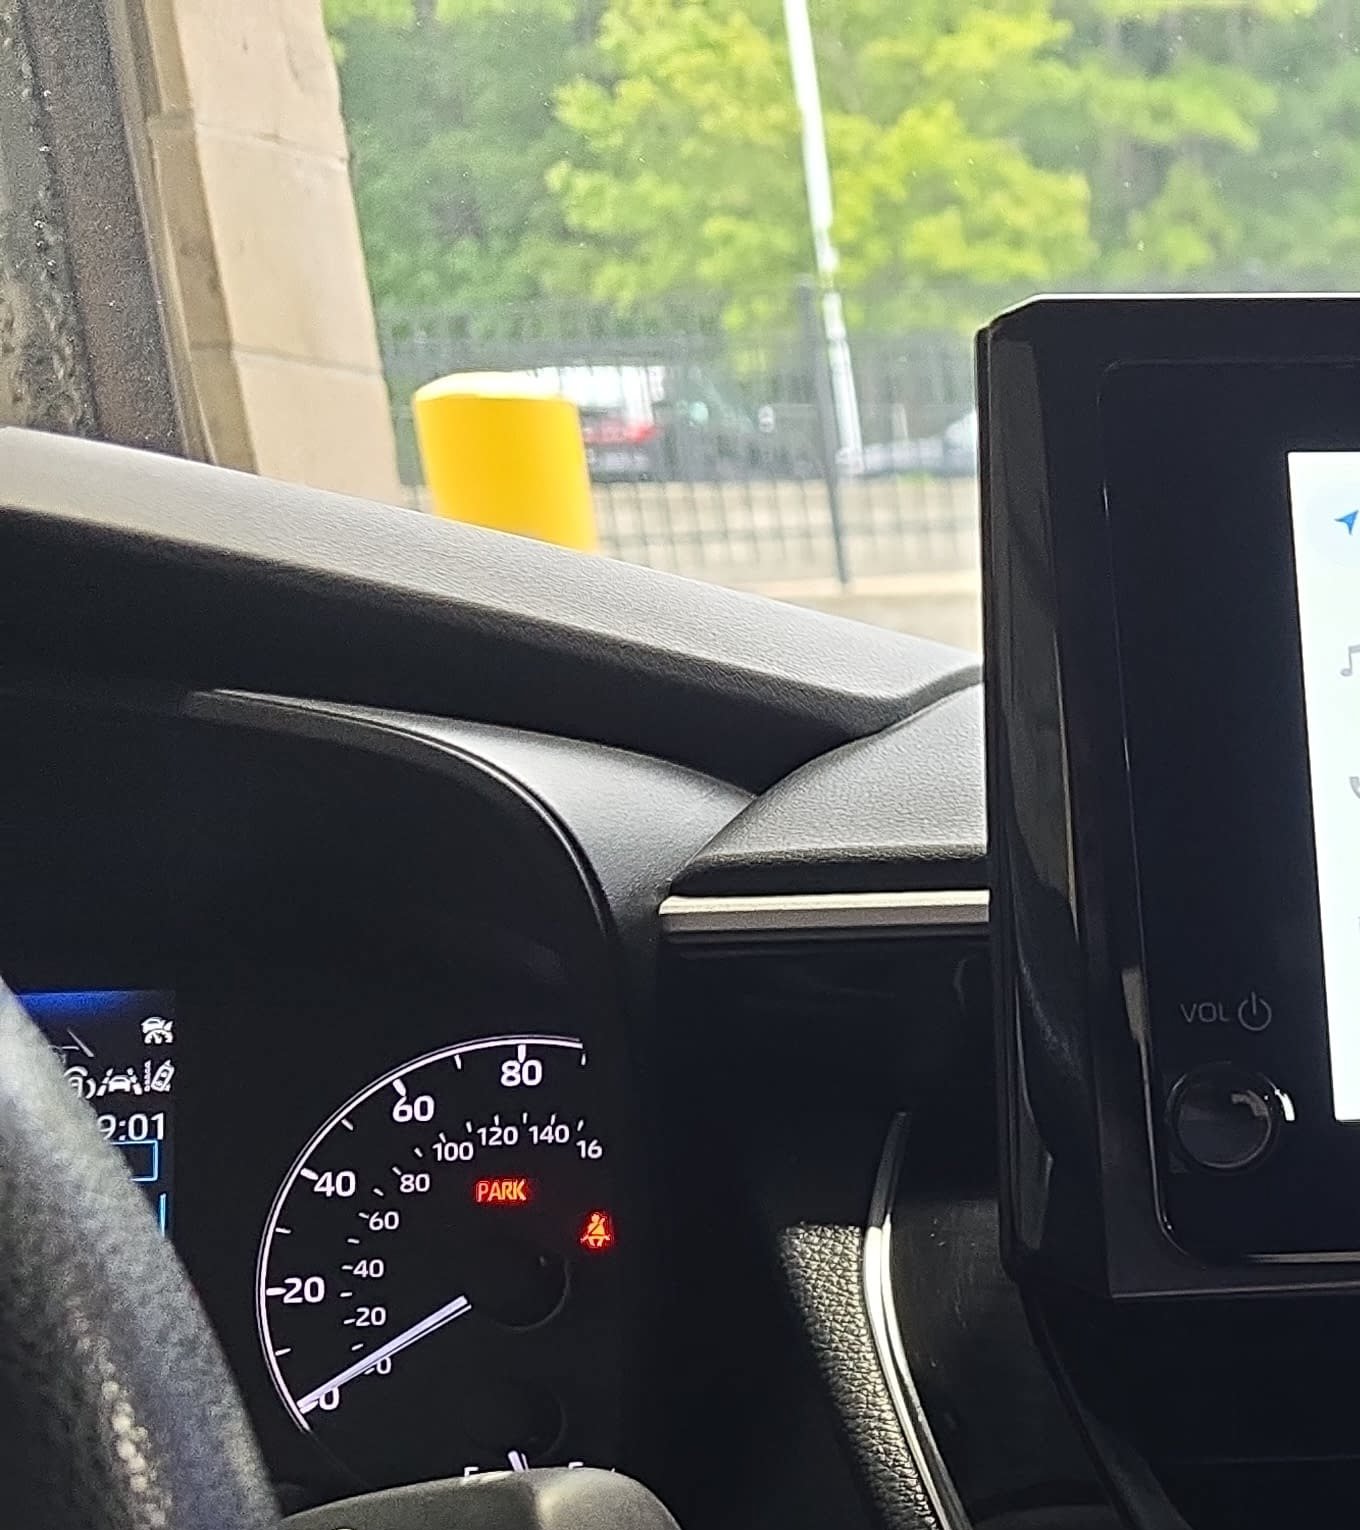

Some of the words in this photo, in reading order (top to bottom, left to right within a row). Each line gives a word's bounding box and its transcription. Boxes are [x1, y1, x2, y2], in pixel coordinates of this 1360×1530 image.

[1180, 1001, 1231, 1023] VOL
[500, 1059, 543, 1087] 80
[392, 1095, 435, 1122] 60
[476, 1126, 519, 1146] 120
[528, 1124, 570, 1144] 140
[432, 1141, 474, 1161] 100
[313, 1170, 356, 1197] 40
[399, 1173, 430, 1193] 80
[476, 1178, 527, 1203] PARK
[368, 1211, 400, 1230] 60
[352, 1259, 385, 1278] 40
[283, 1276, 325, 1303] 20
[355, 1306, 387, 1327] 20
